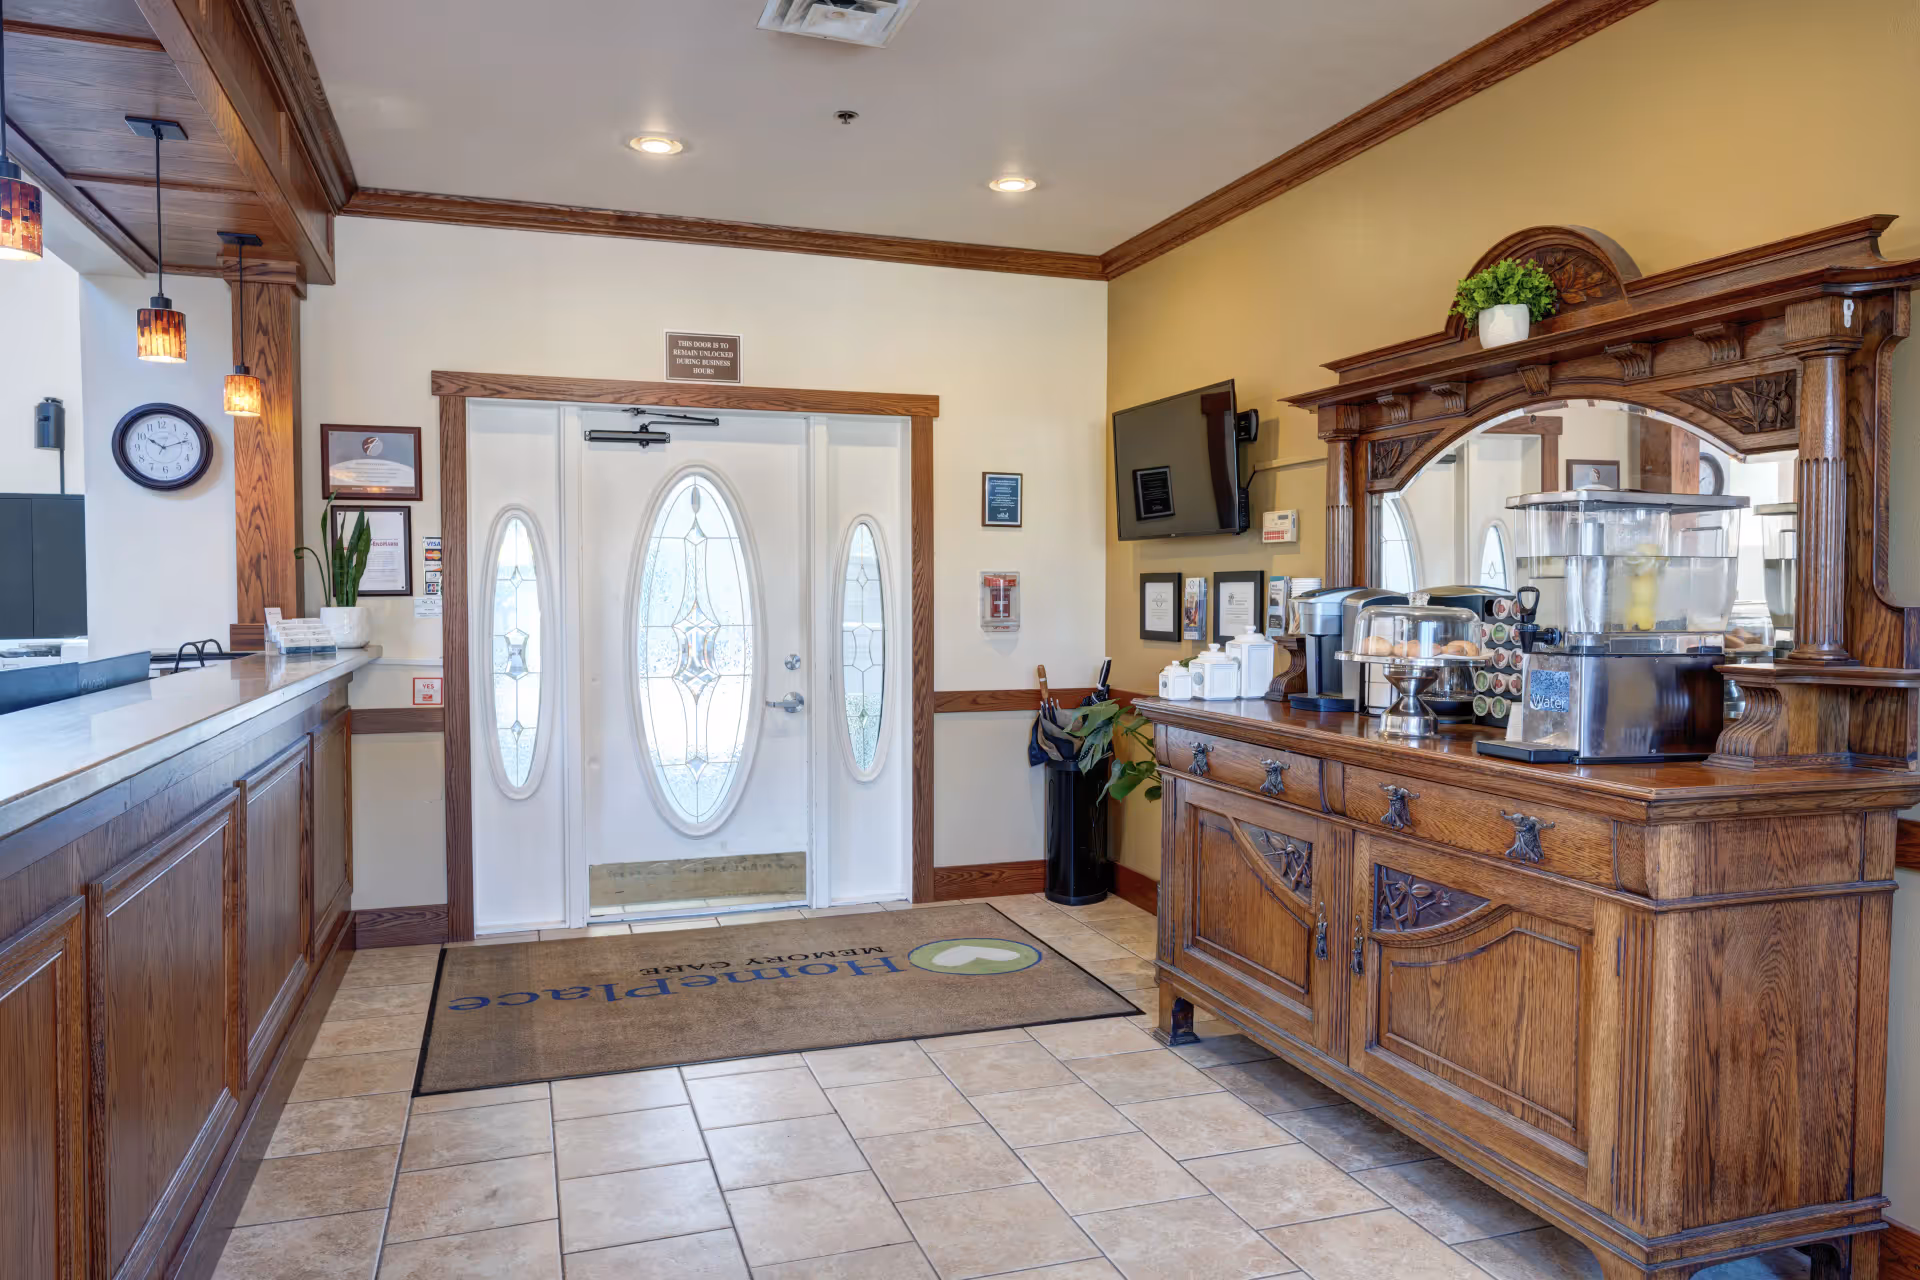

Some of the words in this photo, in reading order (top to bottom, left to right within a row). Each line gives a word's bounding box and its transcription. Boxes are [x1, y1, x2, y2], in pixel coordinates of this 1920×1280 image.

[699, 350, 734, 358] UNLOCKED
[702, 359, 731, 367] BUSINESS
[693, 367, 714, 375] HOURS
[158, 420, 166, 429] 12
[162, 466, 168, 474] 6
[1531, 693, 1566, 710] Water
[746, 946, 888, 966] MEMORY
[639, 961, 731, 976] CARE
[448, 956, 907, 1011] HomePlace
